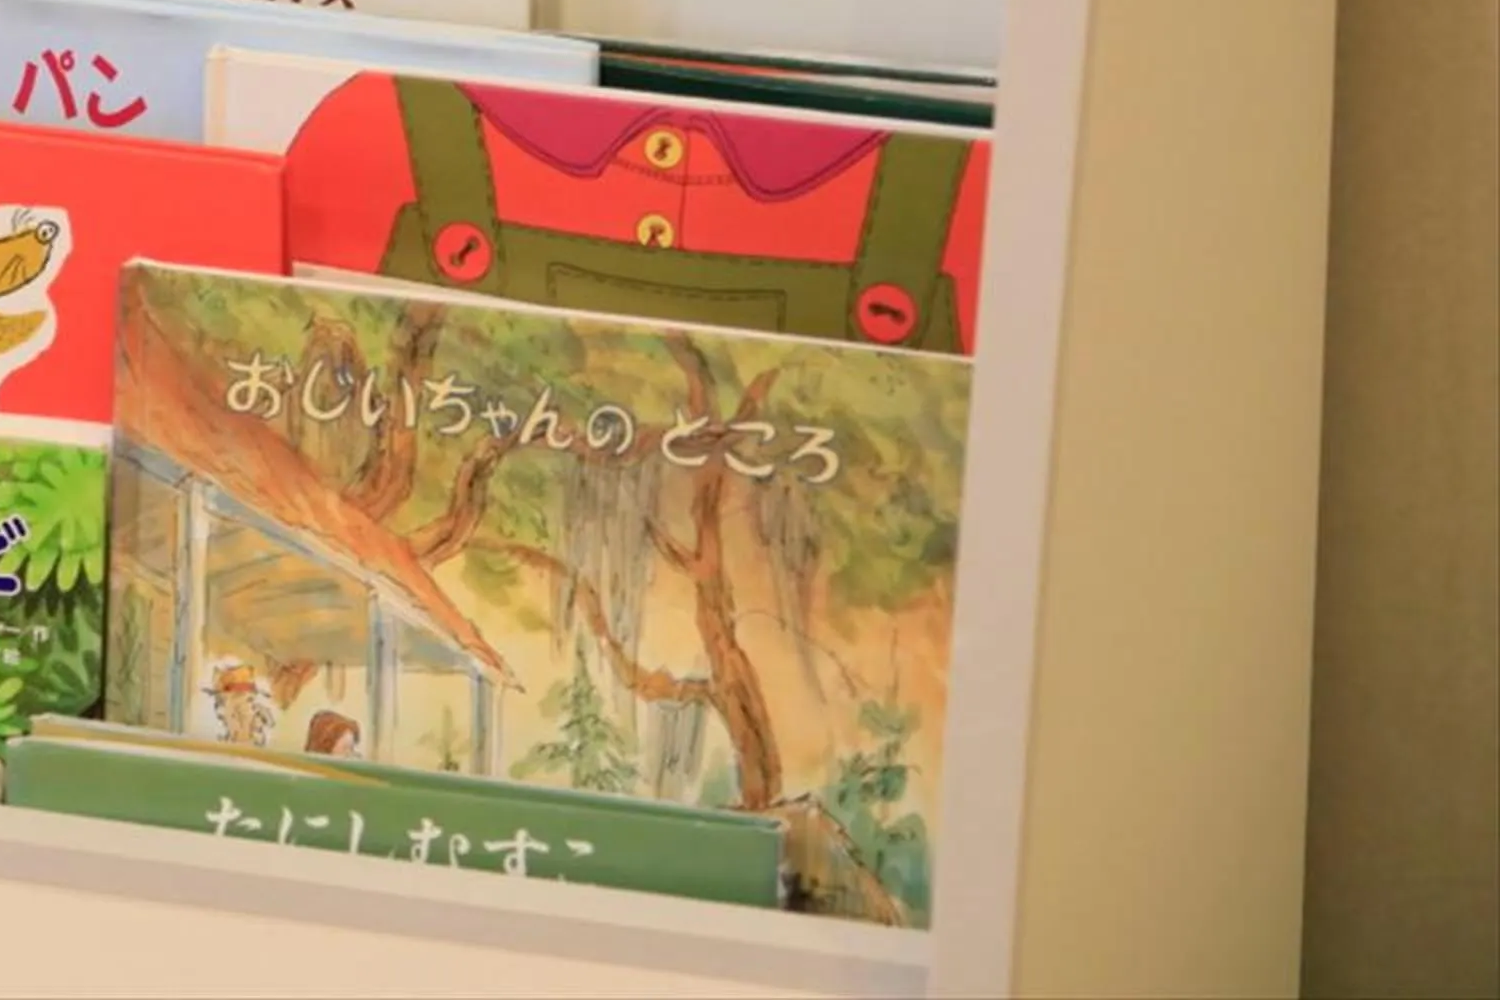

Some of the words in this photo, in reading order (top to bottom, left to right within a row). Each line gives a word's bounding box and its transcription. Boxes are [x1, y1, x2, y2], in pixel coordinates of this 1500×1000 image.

[12, 48, 147, 130] パン
[224, 351, 635, 456] おじいちゃんの
[660, 413, 842, 484] ところ
